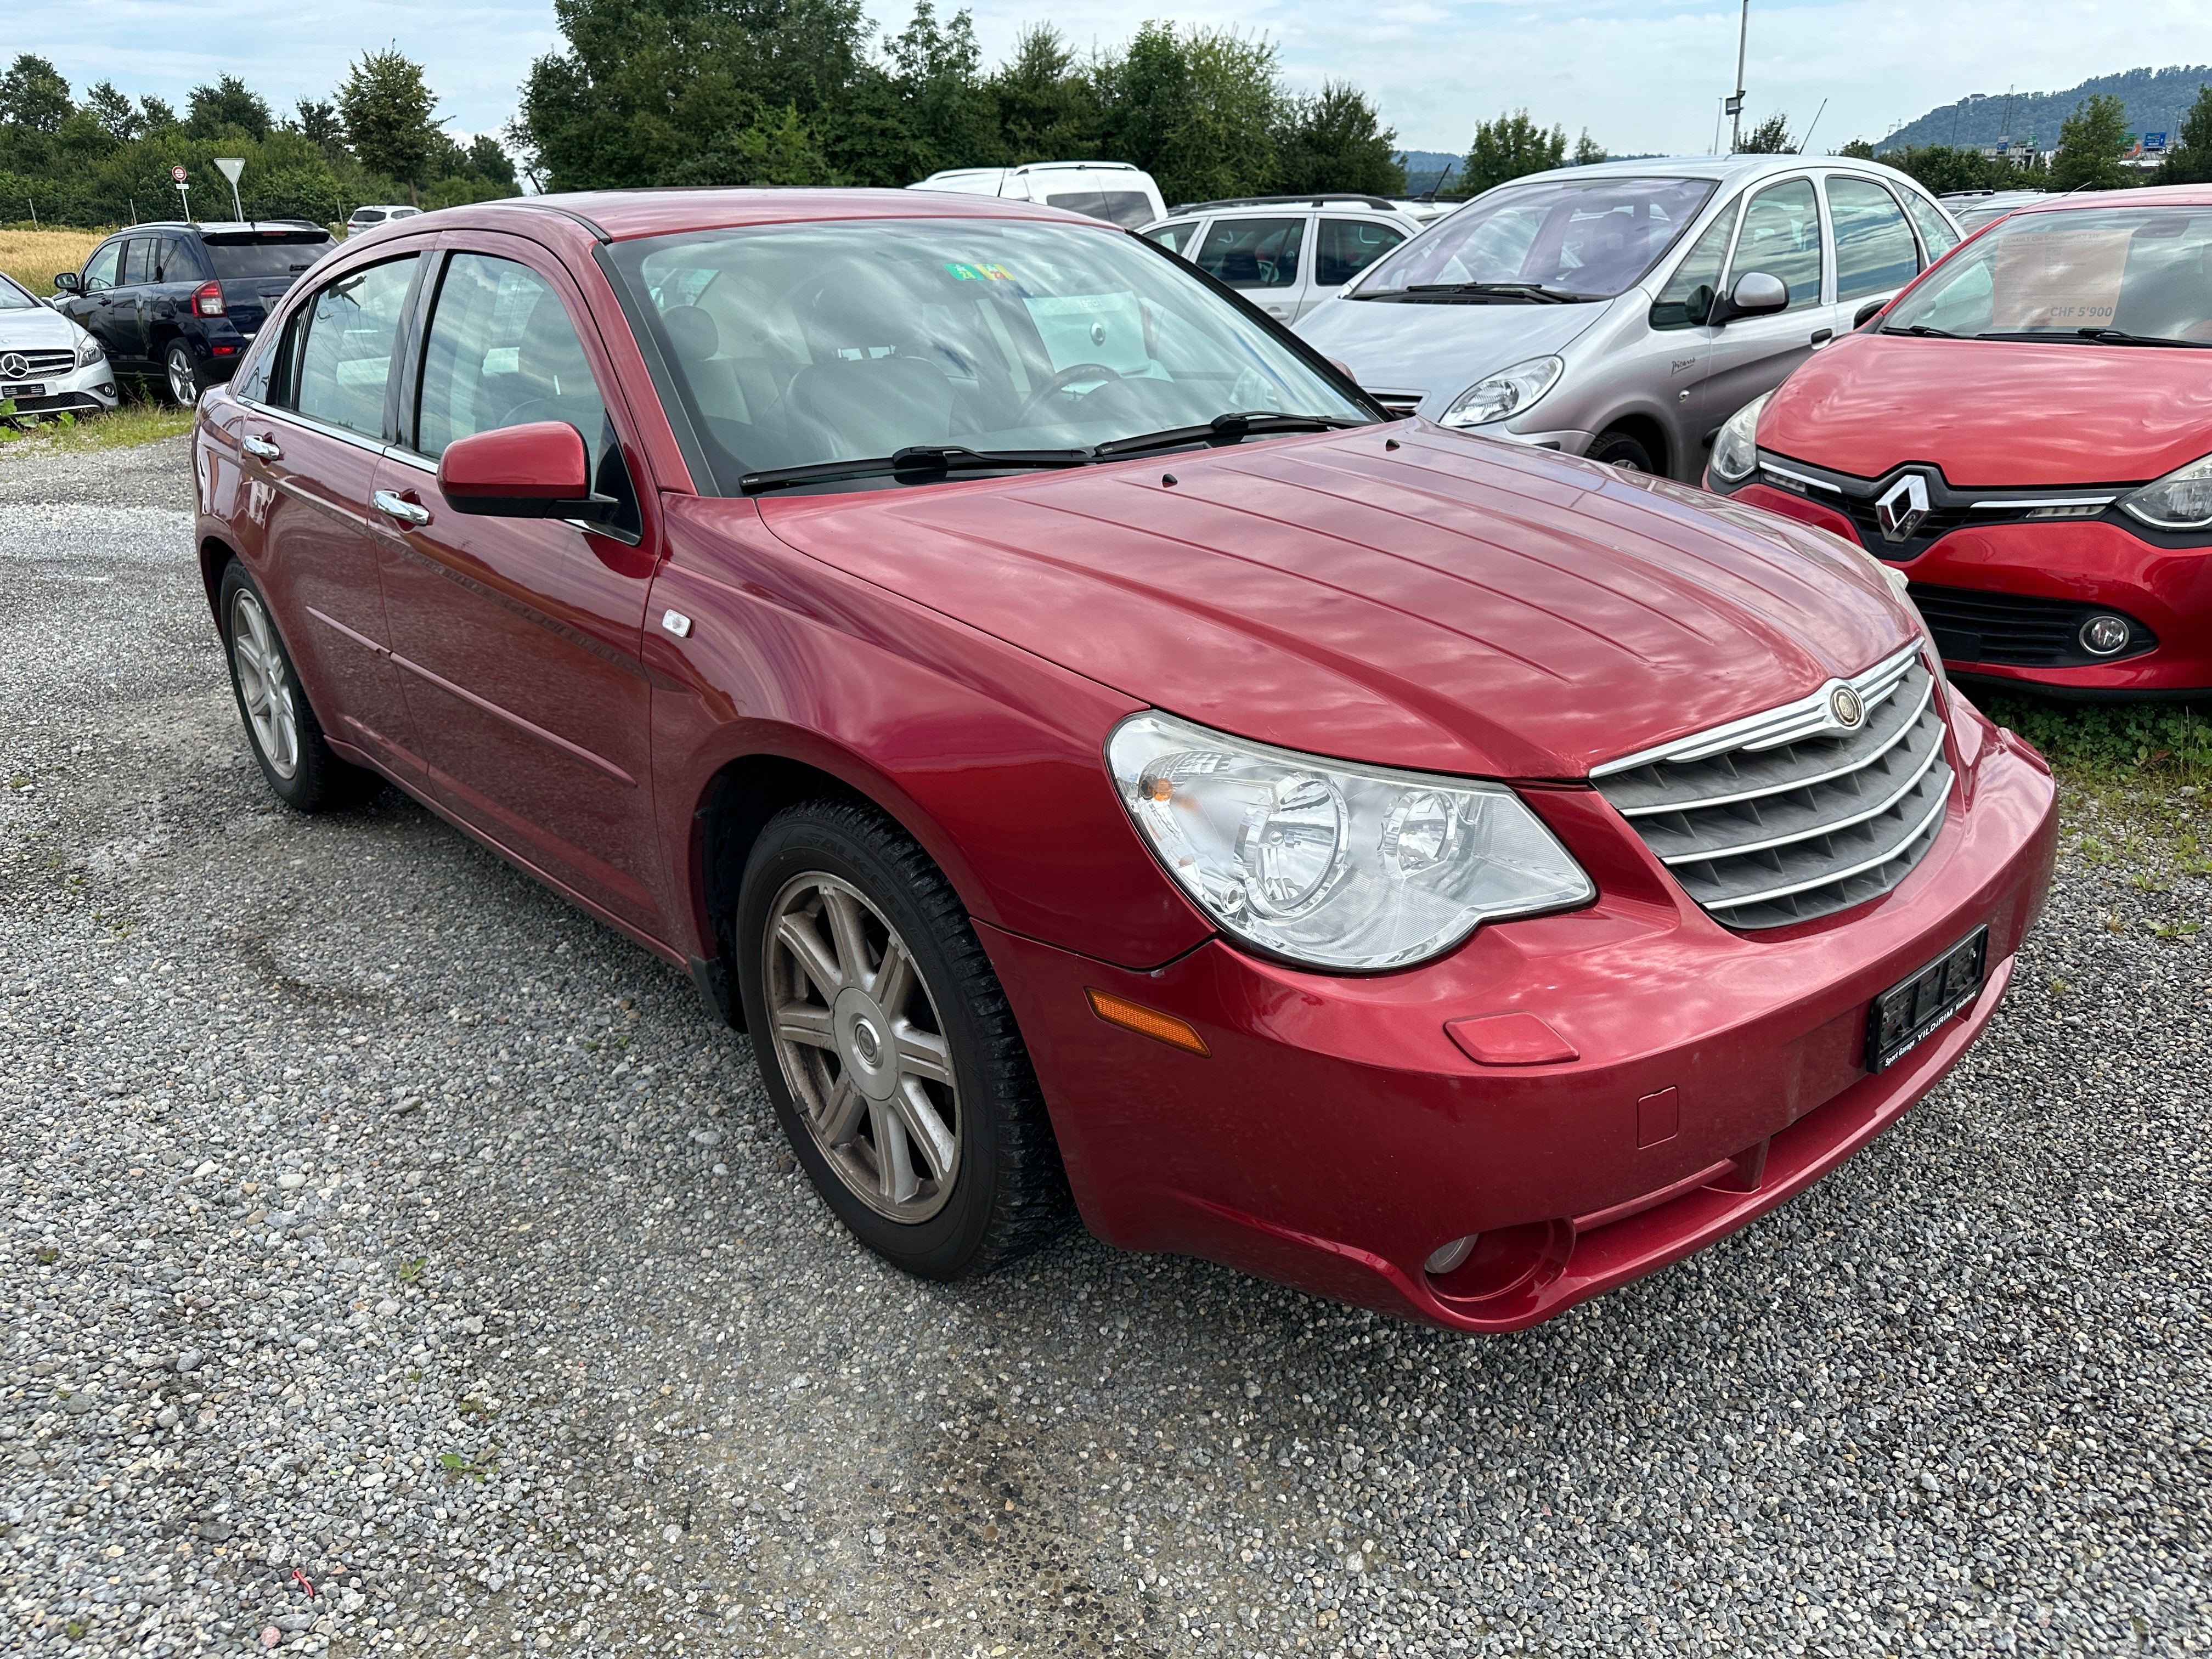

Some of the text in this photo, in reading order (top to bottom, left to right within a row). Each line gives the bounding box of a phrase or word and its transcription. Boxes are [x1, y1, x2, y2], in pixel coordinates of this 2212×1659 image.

[2050, 307, 2113, 317] CHF 5'900
[1885, 1051, 1898, 1066] Sport
[1899, 1040, 1915, 1056] Garage
[1917, 1008, 1954, 1041] YILDIRIM
